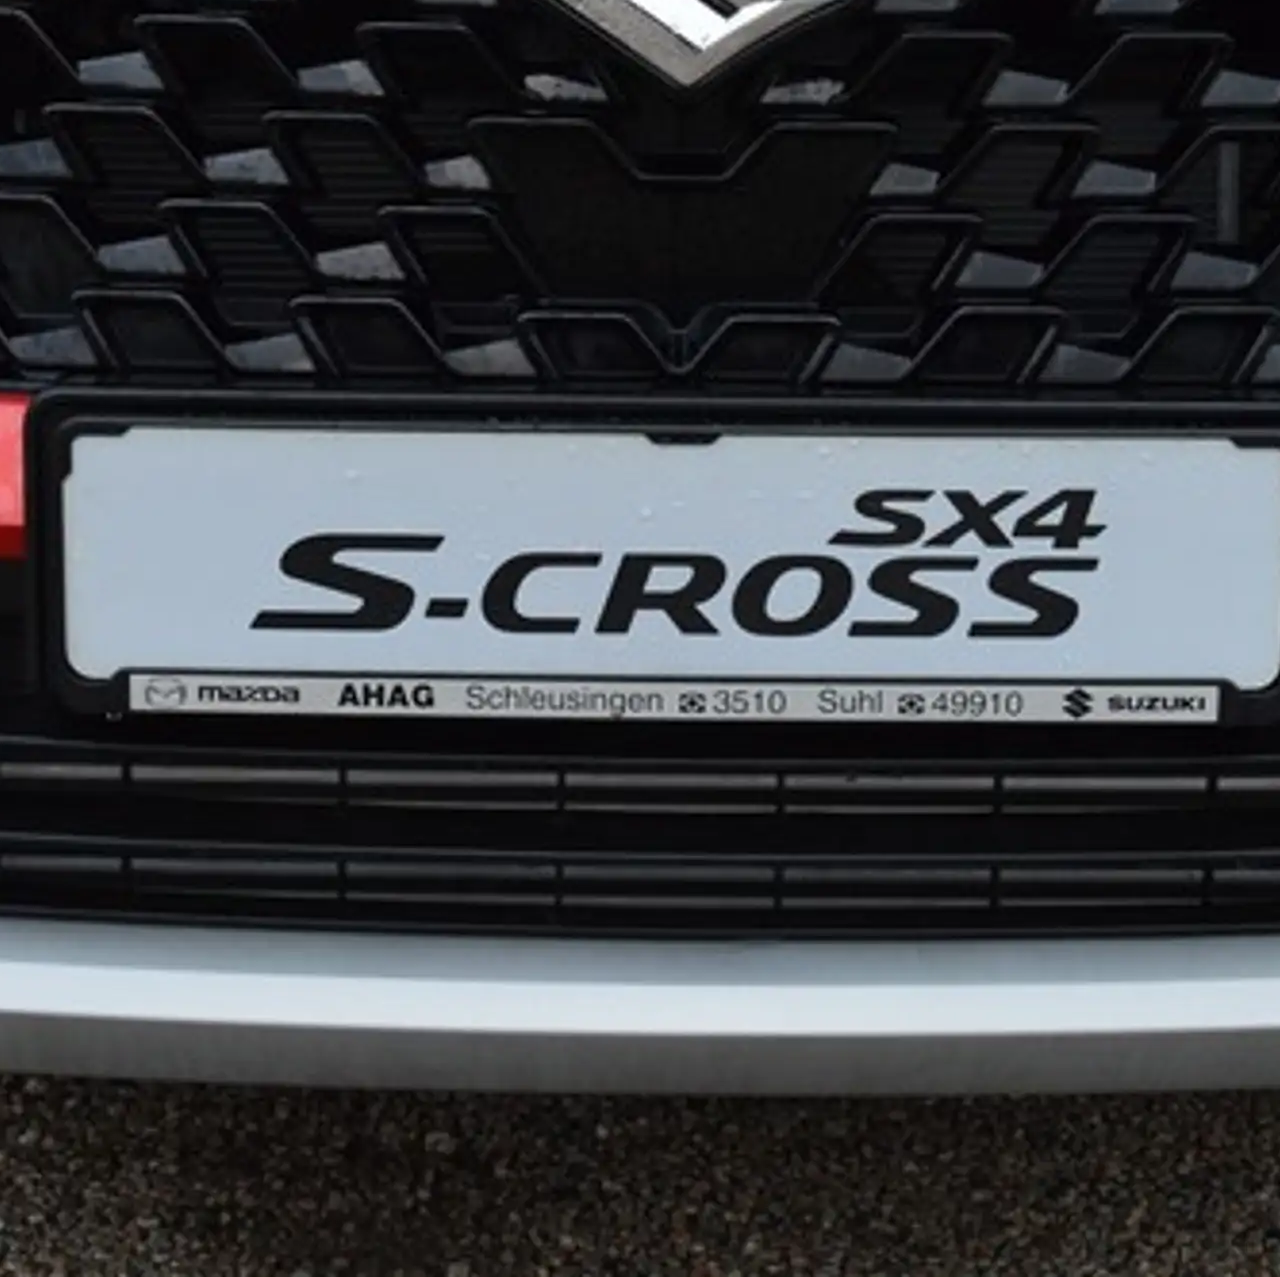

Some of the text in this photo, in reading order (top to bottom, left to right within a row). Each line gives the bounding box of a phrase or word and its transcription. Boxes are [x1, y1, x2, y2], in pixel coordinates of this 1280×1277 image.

[828, 488, 1108, 549] SX4
[249, 533, 1101, 638] S-CROSS
[196, 684, 1207, 719] mazda AHAG Schleusingen 3510 Suhl 49910 SUZUKI
